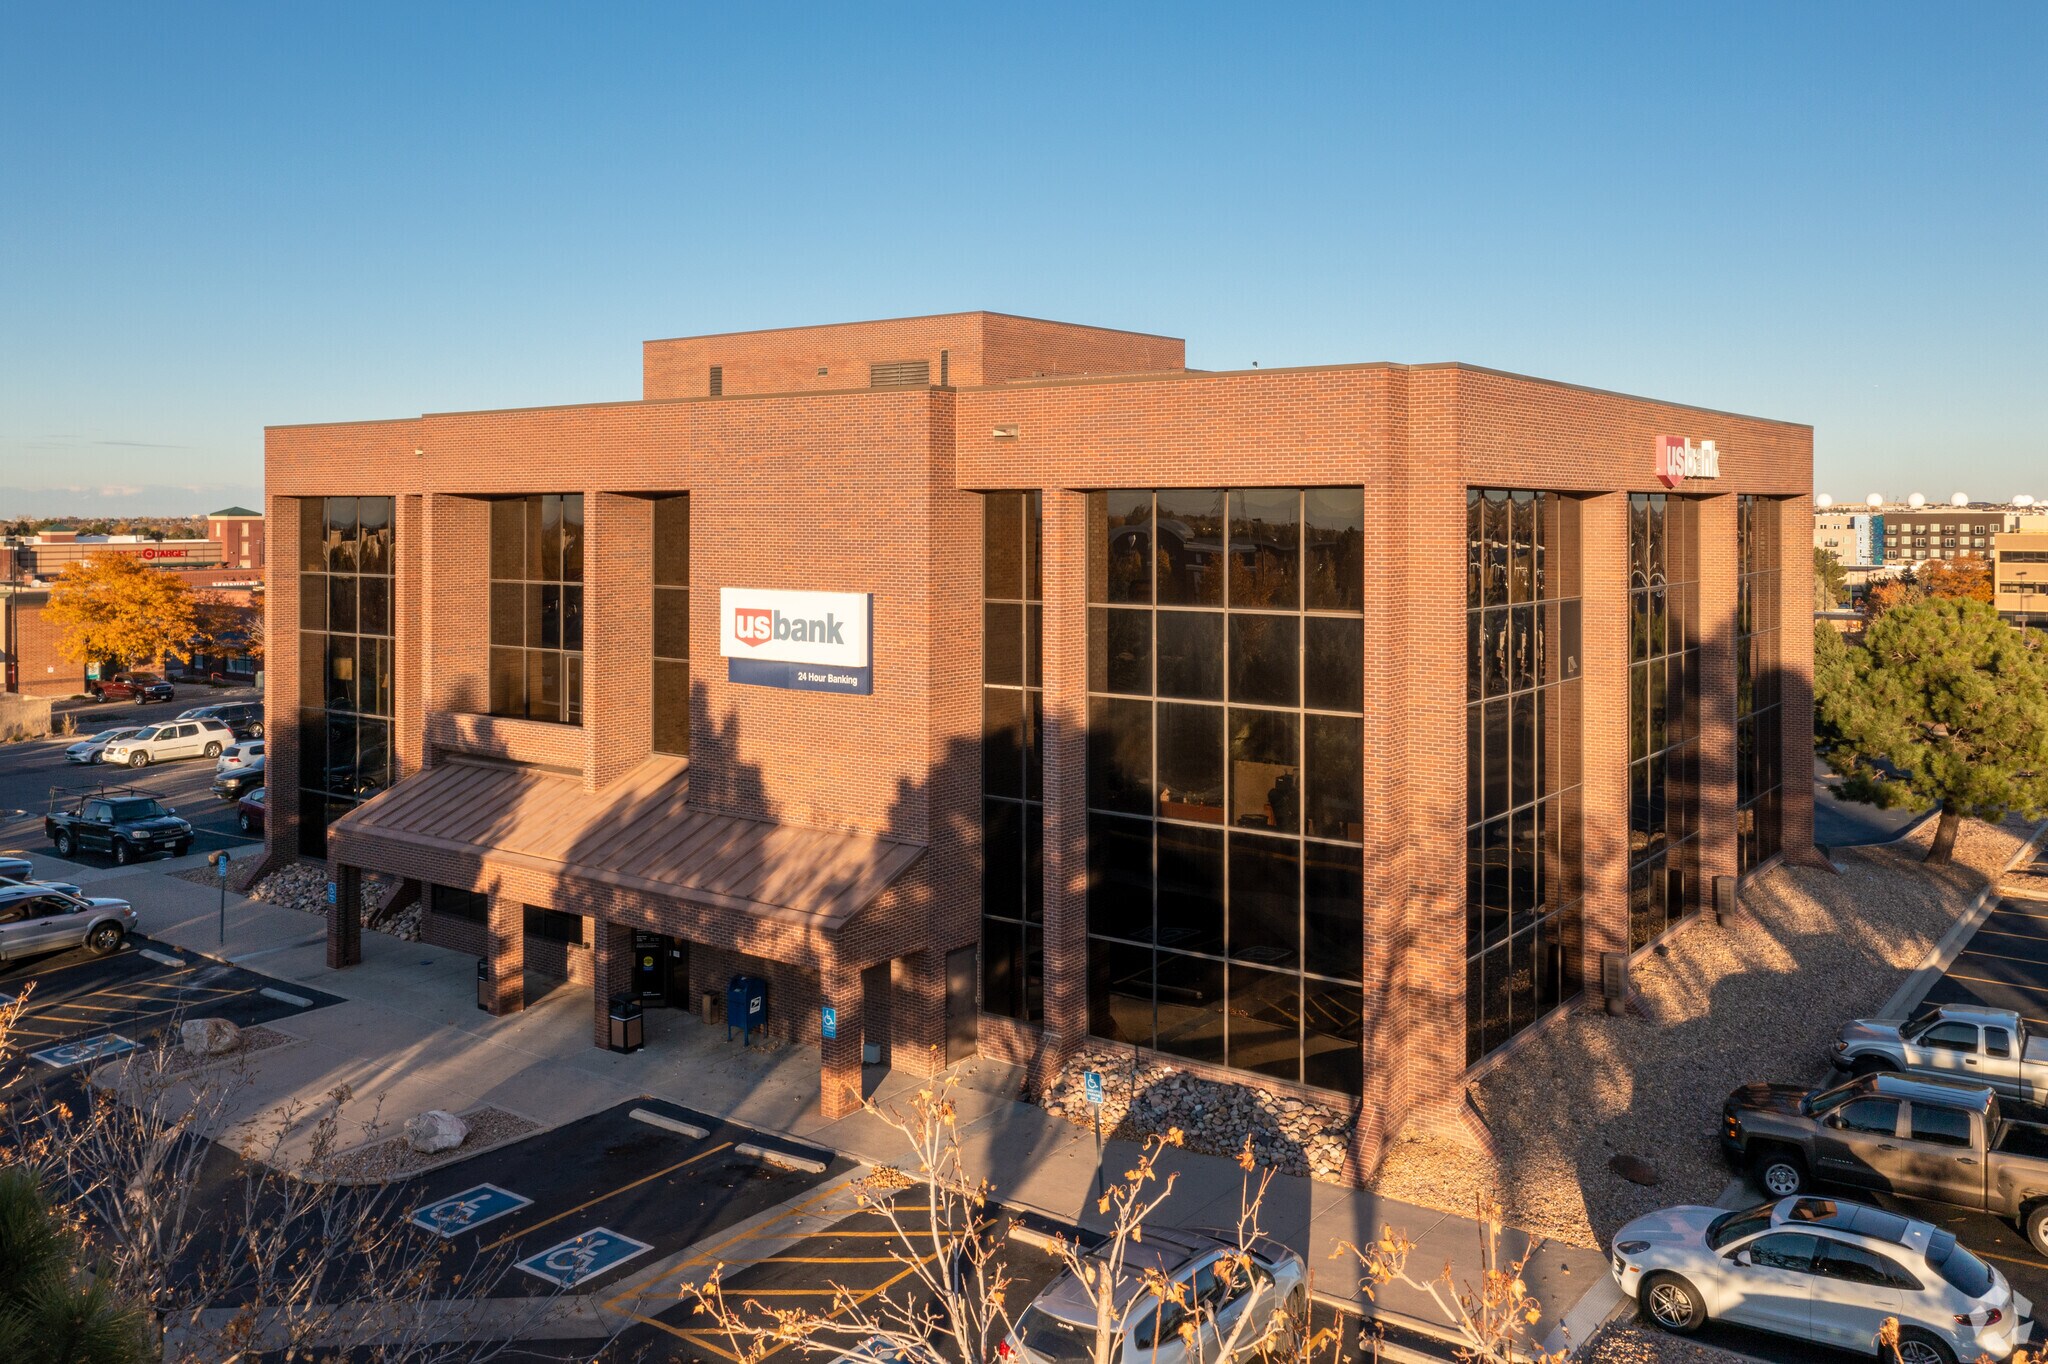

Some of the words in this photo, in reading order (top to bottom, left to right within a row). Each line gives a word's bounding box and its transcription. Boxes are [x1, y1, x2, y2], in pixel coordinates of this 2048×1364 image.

[155, 549, 188, 558] TARGET
[798, 672, 807, 681] 24
[808, 672, 827, 682] Hour
[827, 674, 858, 687] Banking
